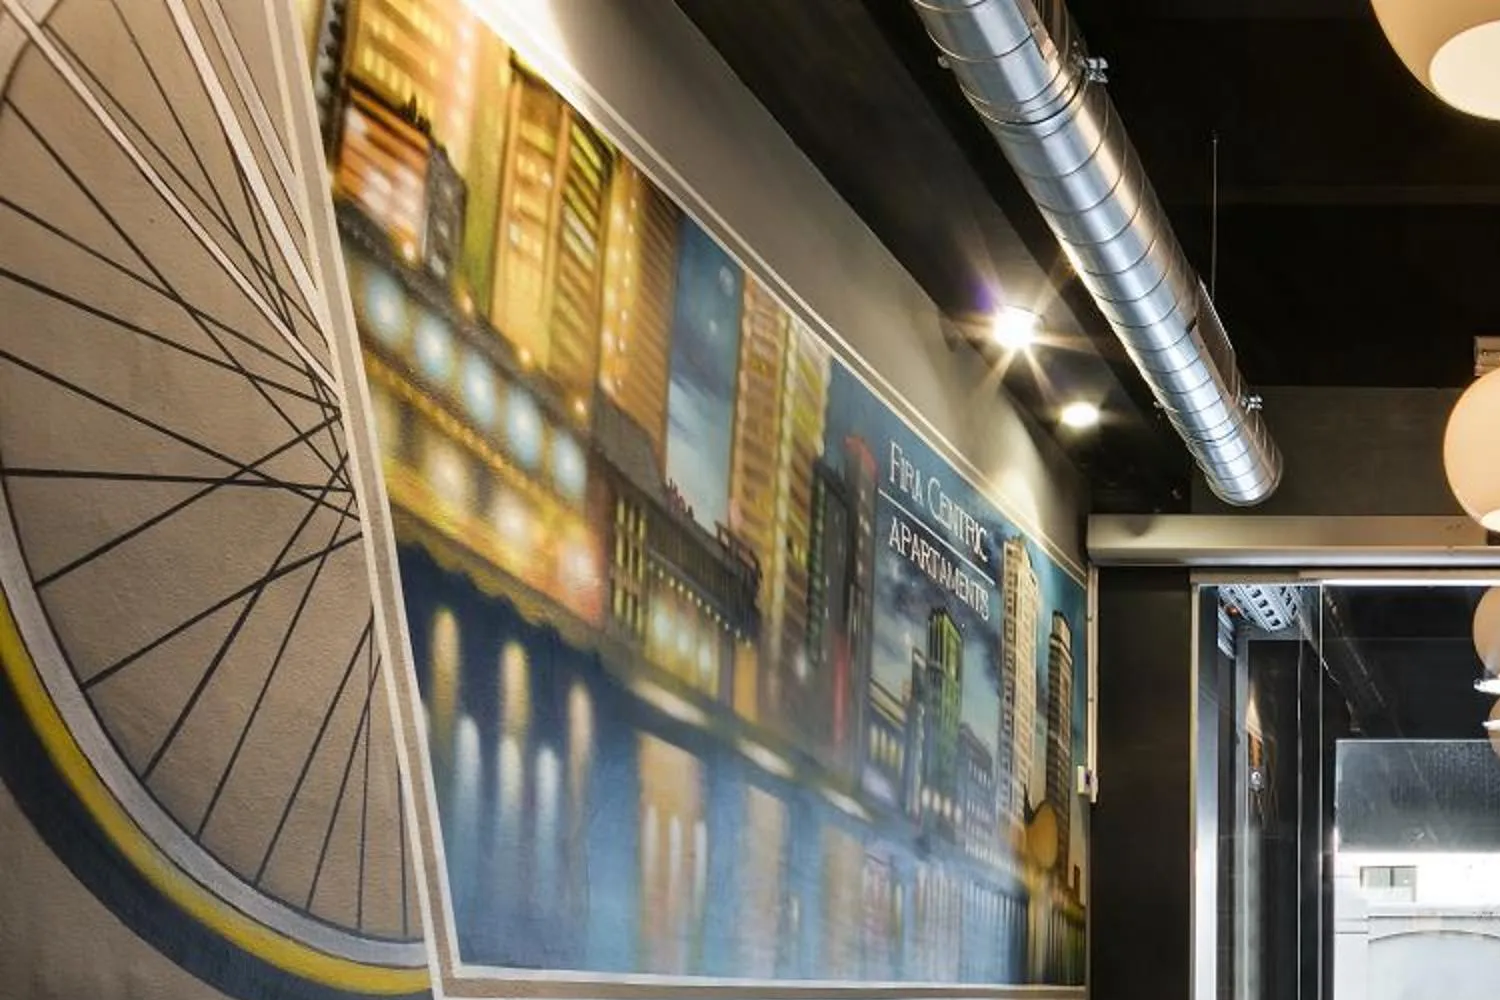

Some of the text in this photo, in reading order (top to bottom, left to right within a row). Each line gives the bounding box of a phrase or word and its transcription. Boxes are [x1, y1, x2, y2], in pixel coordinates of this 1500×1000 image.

[889, 440, 989, 562] FIRA CENTRIC
[888, 516, 990, 621] APARTAMENTS
